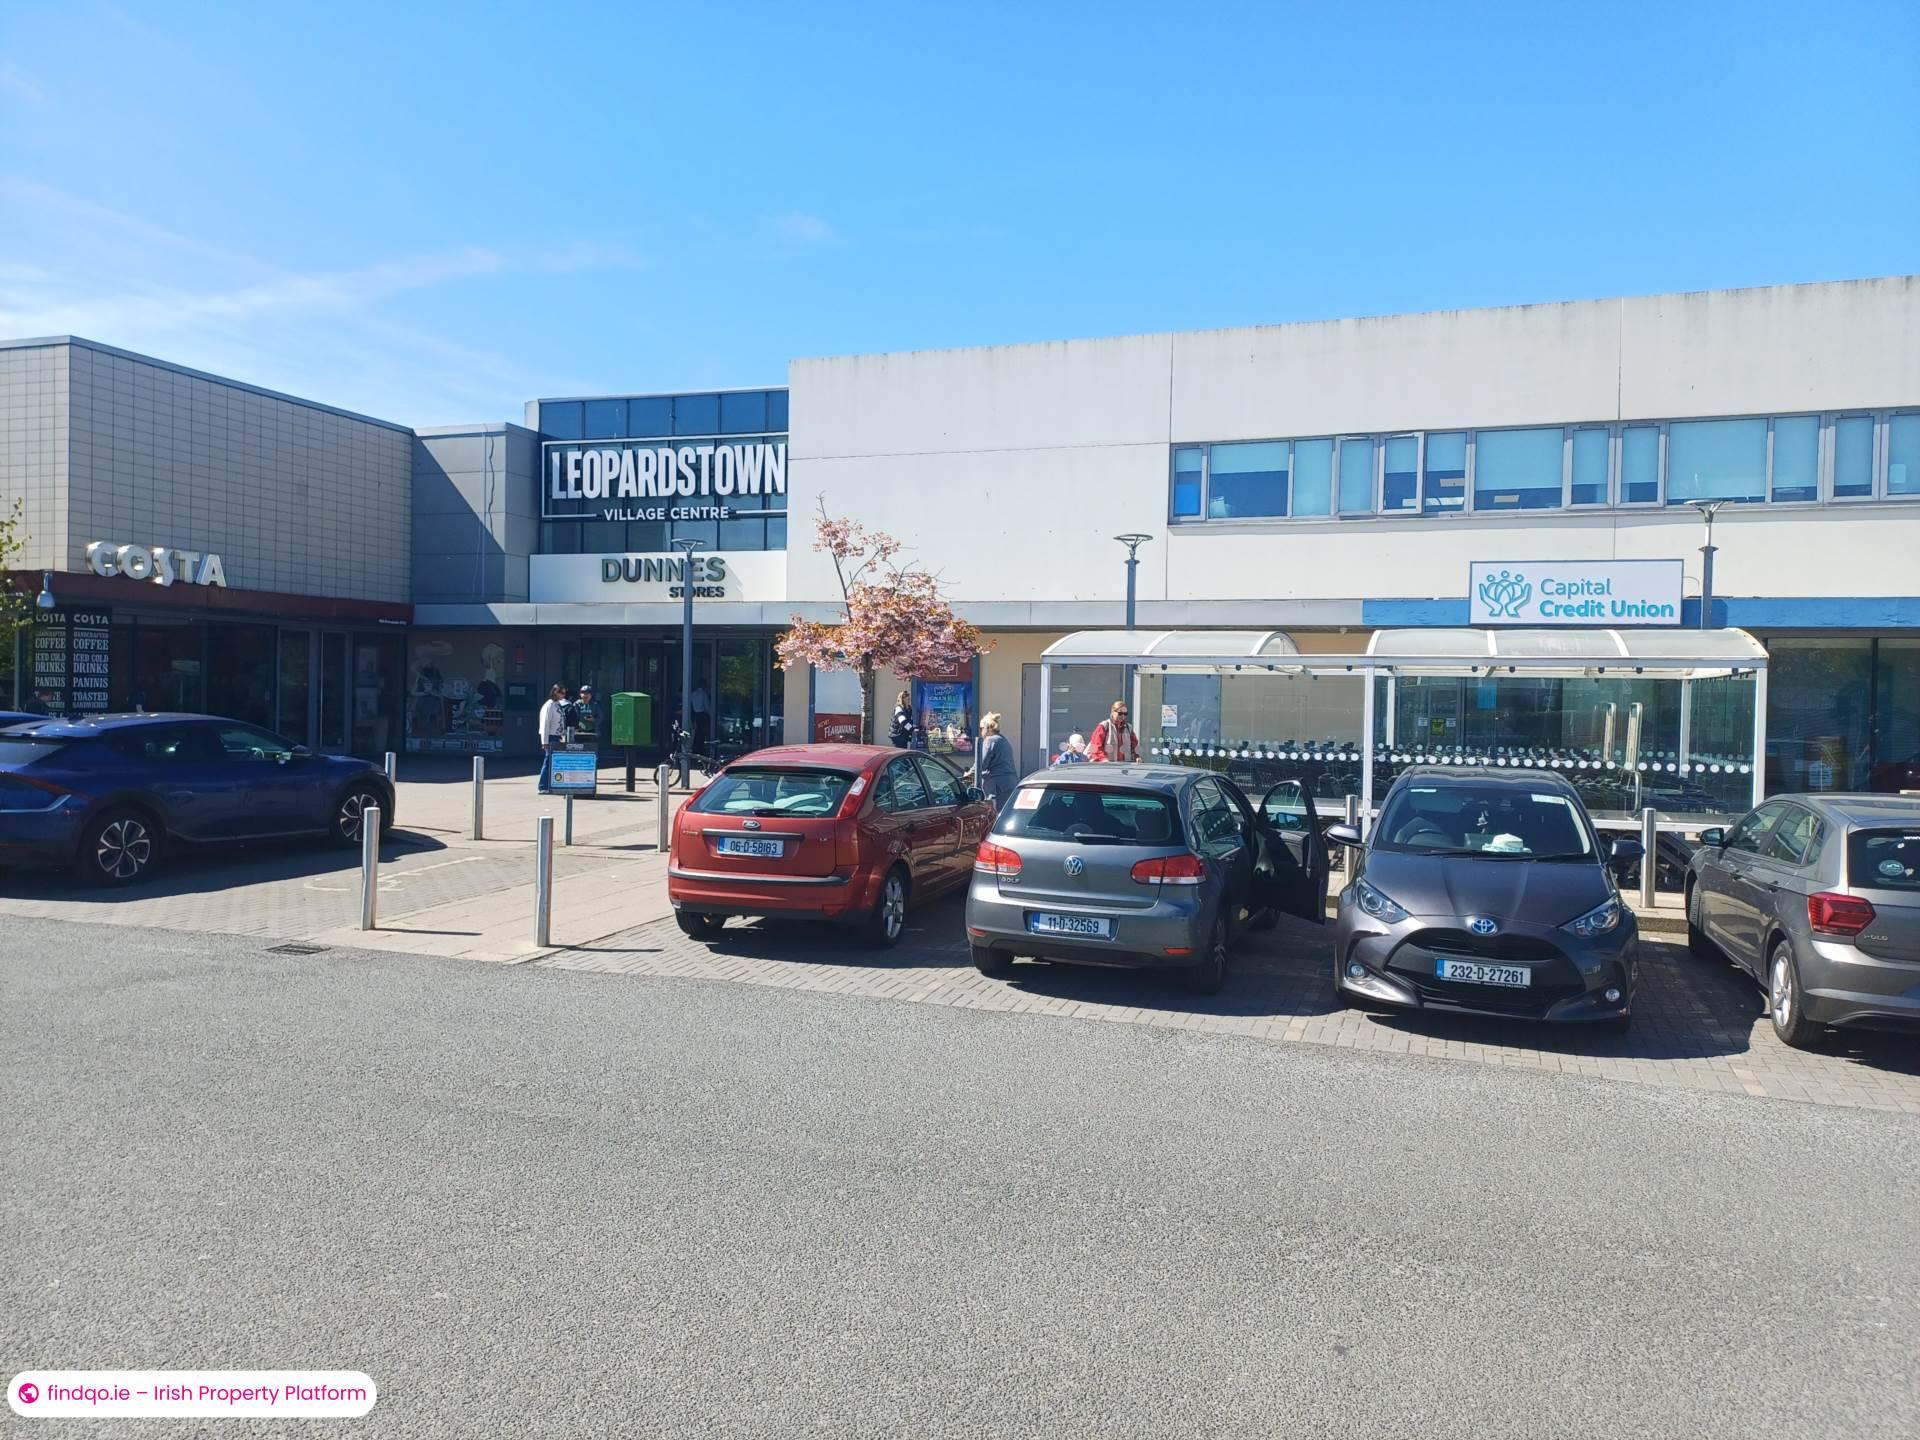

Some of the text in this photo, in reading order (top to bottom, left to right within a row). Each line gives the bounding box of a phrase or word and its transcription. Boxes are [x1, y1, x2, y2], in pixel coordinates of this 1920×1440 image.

[552, 443, 786, 499] LEOPARDSTOWN
[604, 506, 729, 521] VILLAGE CENTRE
[86, 541, 227, 587] COSTA
[601, 557, 726, 582] DUNNES
[1540, 578, 1612, 599] Capital
[1539, 599, 1675, 617] Credit Union
[73, 614, 109, 625] COSTA
[35, 638, 66, 649] COFFEE
[73, 638, 109, 650] COFFEE
[73, 653, 109, 663] ICED COLD
[35, 662, 66, 673] DRINKS
[73, 662, 109, 674] DRINKS
[35, 677, 66, 687] PANINIS
[73, 677, 109, 688] PANINIS
[72, 692, 108, 701] TOASTED
[730, 841, 778, 854] 06-D-58183
[1048, 917, 1099, 933] 11-D-32569
[1450, 965, 1524, 984] 232-D-27261
